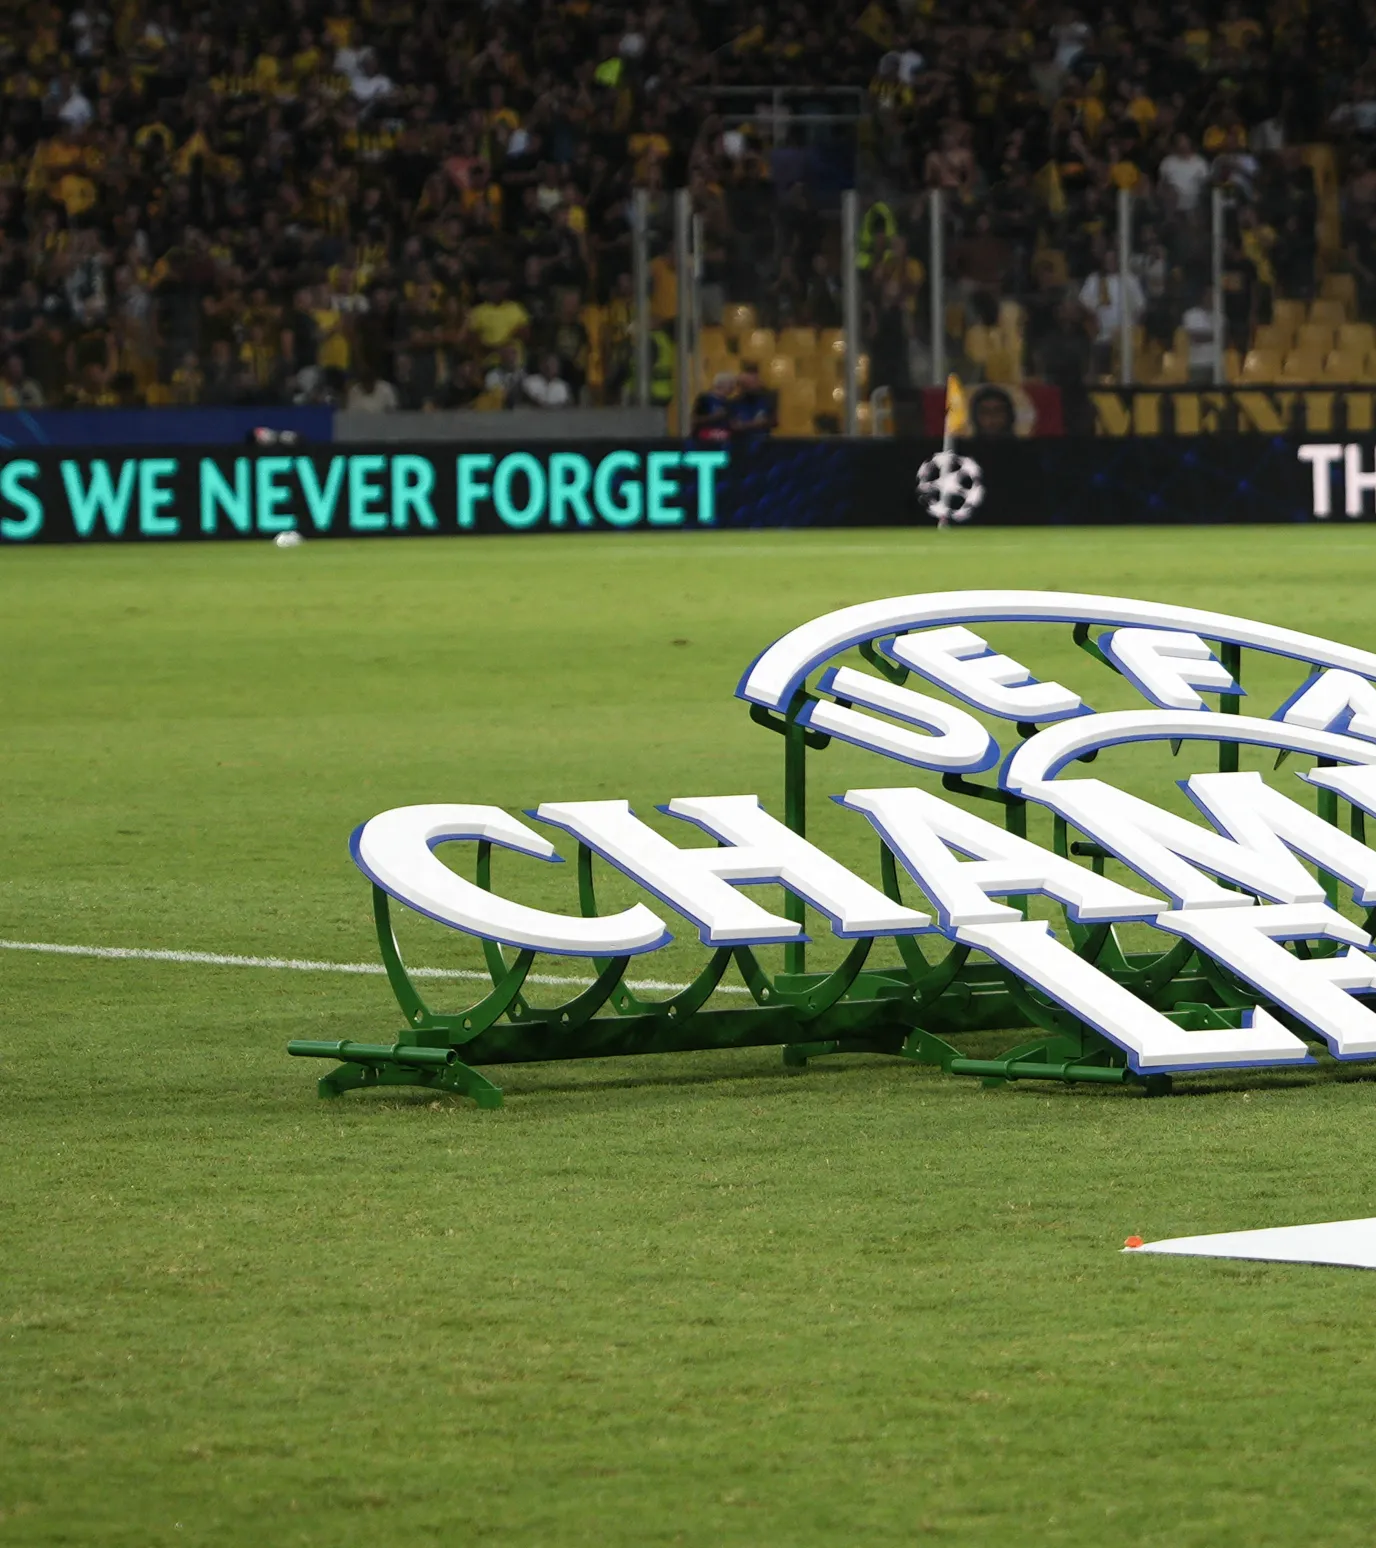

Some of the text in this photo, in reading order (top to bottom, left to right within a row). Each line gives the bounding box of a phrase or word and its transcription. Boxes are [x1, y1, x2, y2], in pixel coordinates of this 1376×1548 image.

[61, 457, 180, 537] WE
[200, 454, 438, 533] NEVER
[456, 450, 729, 530] FORGET
